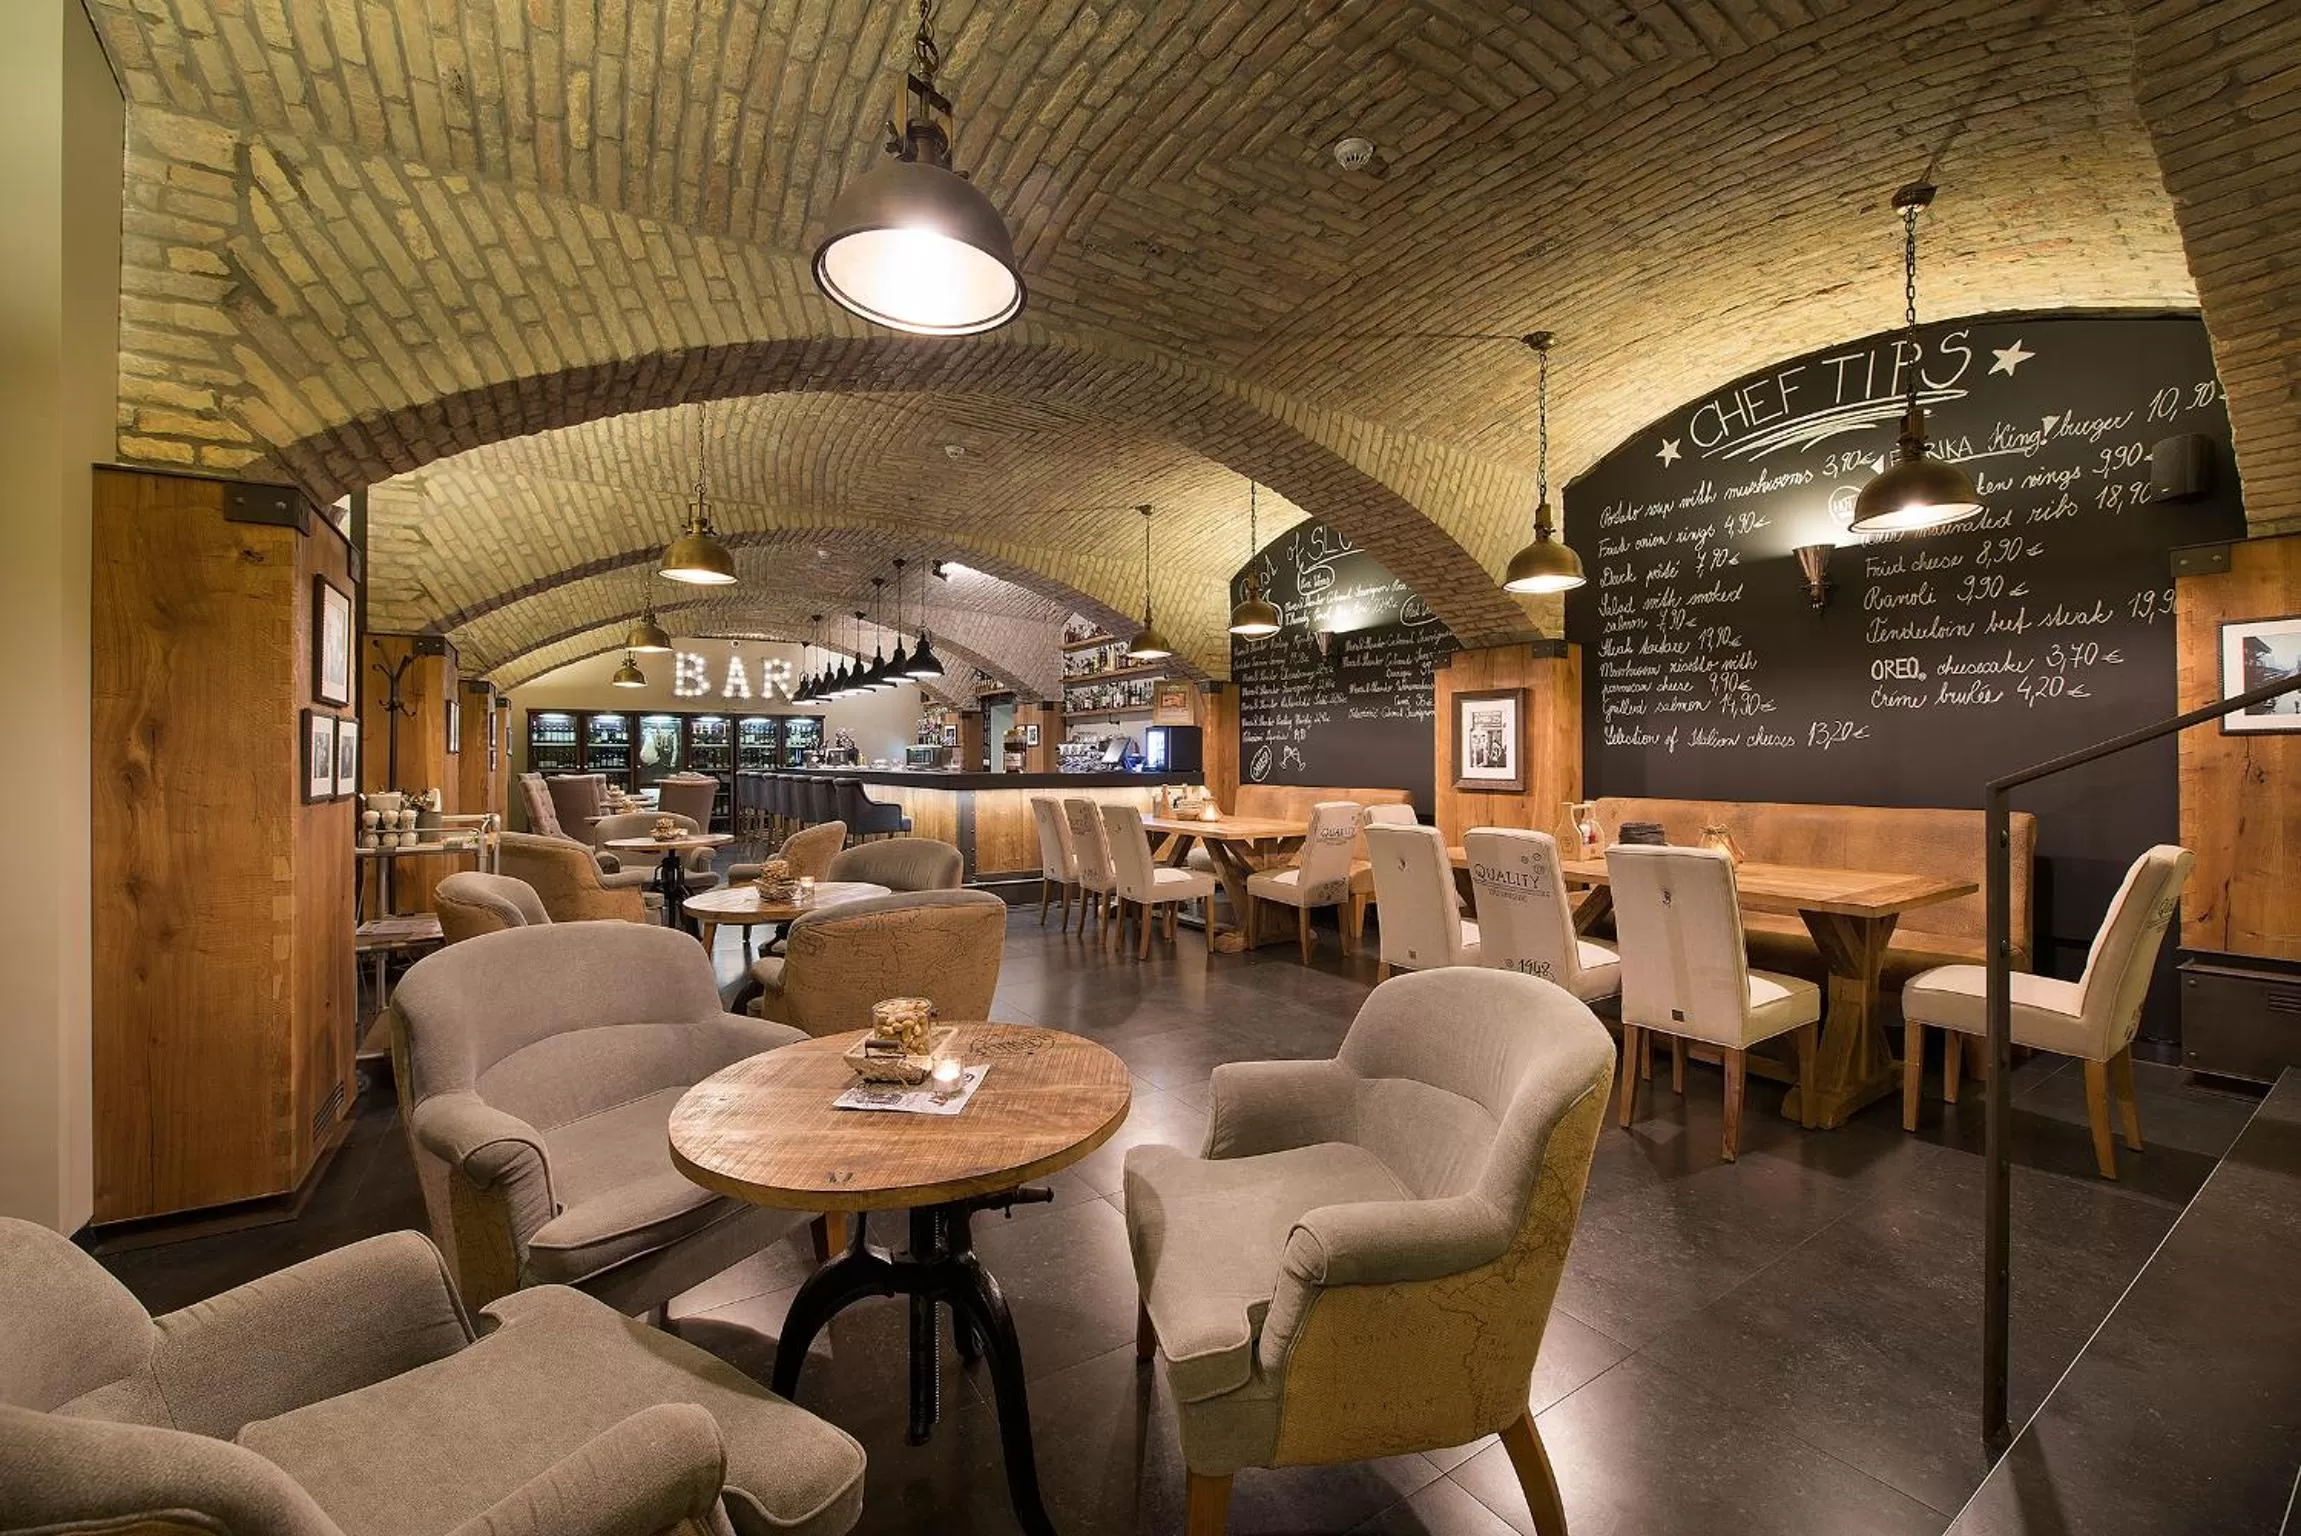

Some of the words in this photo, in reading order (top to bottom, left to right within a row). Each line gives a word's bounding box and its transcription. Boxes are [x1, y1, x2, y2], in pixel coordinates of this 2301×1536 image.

[1690, 366, 1806, 448] CHEF
[1822, 329, 1972, 404] TIPS
[2053, 409, 2134, 443] burger
[2021, 465, 2081, 490] wings
[1600, 500, 1643, 529] Potato
[1645, 500, 1675, 522] soup
[1679, 480, 1717, 508] with
[1724, 467, 1813, 499] mushrooms
[2026, 493, 2078, 524] ribs
[1598, 537, 1631, 559] Fried
[1635, 532, 1672, 551] onion
[1675, 521, 1716, 552] rings
[1600, 562, 1637, 589] Duck
[1865, 556, 1907, 578] Fried
[1911, 551, 1964, 572] cheese
[1598, 591, 1637, 618] Salad
[1642, 586, 1682, 611] with
[1686, 580, 1744, 606] smoked
[1863, 581, 1937, 610] Ravioli
[1603, 615, 1648, 633] salmon
[1866, 615, 1975, 643] Tenderloin
[1984, 607, 2032, 634] beef
[2037, 600, 2114, 627] steak
[1598, 636, 1634, 658] Steak
[674, 652, 795, 702] BAR
[1600, 659, 1661, 678] Mushroom
[1670, 655, 1719, 674] risotto
[1721, 649, 1758, 671] with
[1871, 656, 1921, 681] OREO
[1937, 650, 2035, 675] cheesecake
[1656, 675, 1694, 693] cheese
[1602, 697, 1648, 722] Grilled
[1655, 695, 1712, 712] salmon
[1603, 725, 1661, 747] Selection
[1664, 725, 1679, 754] of
[1687, 727, 1740, 748] Italian
[1746, 725, 1796, 748] cheeses
[1474, 863, 1540, 889] QUALITY
